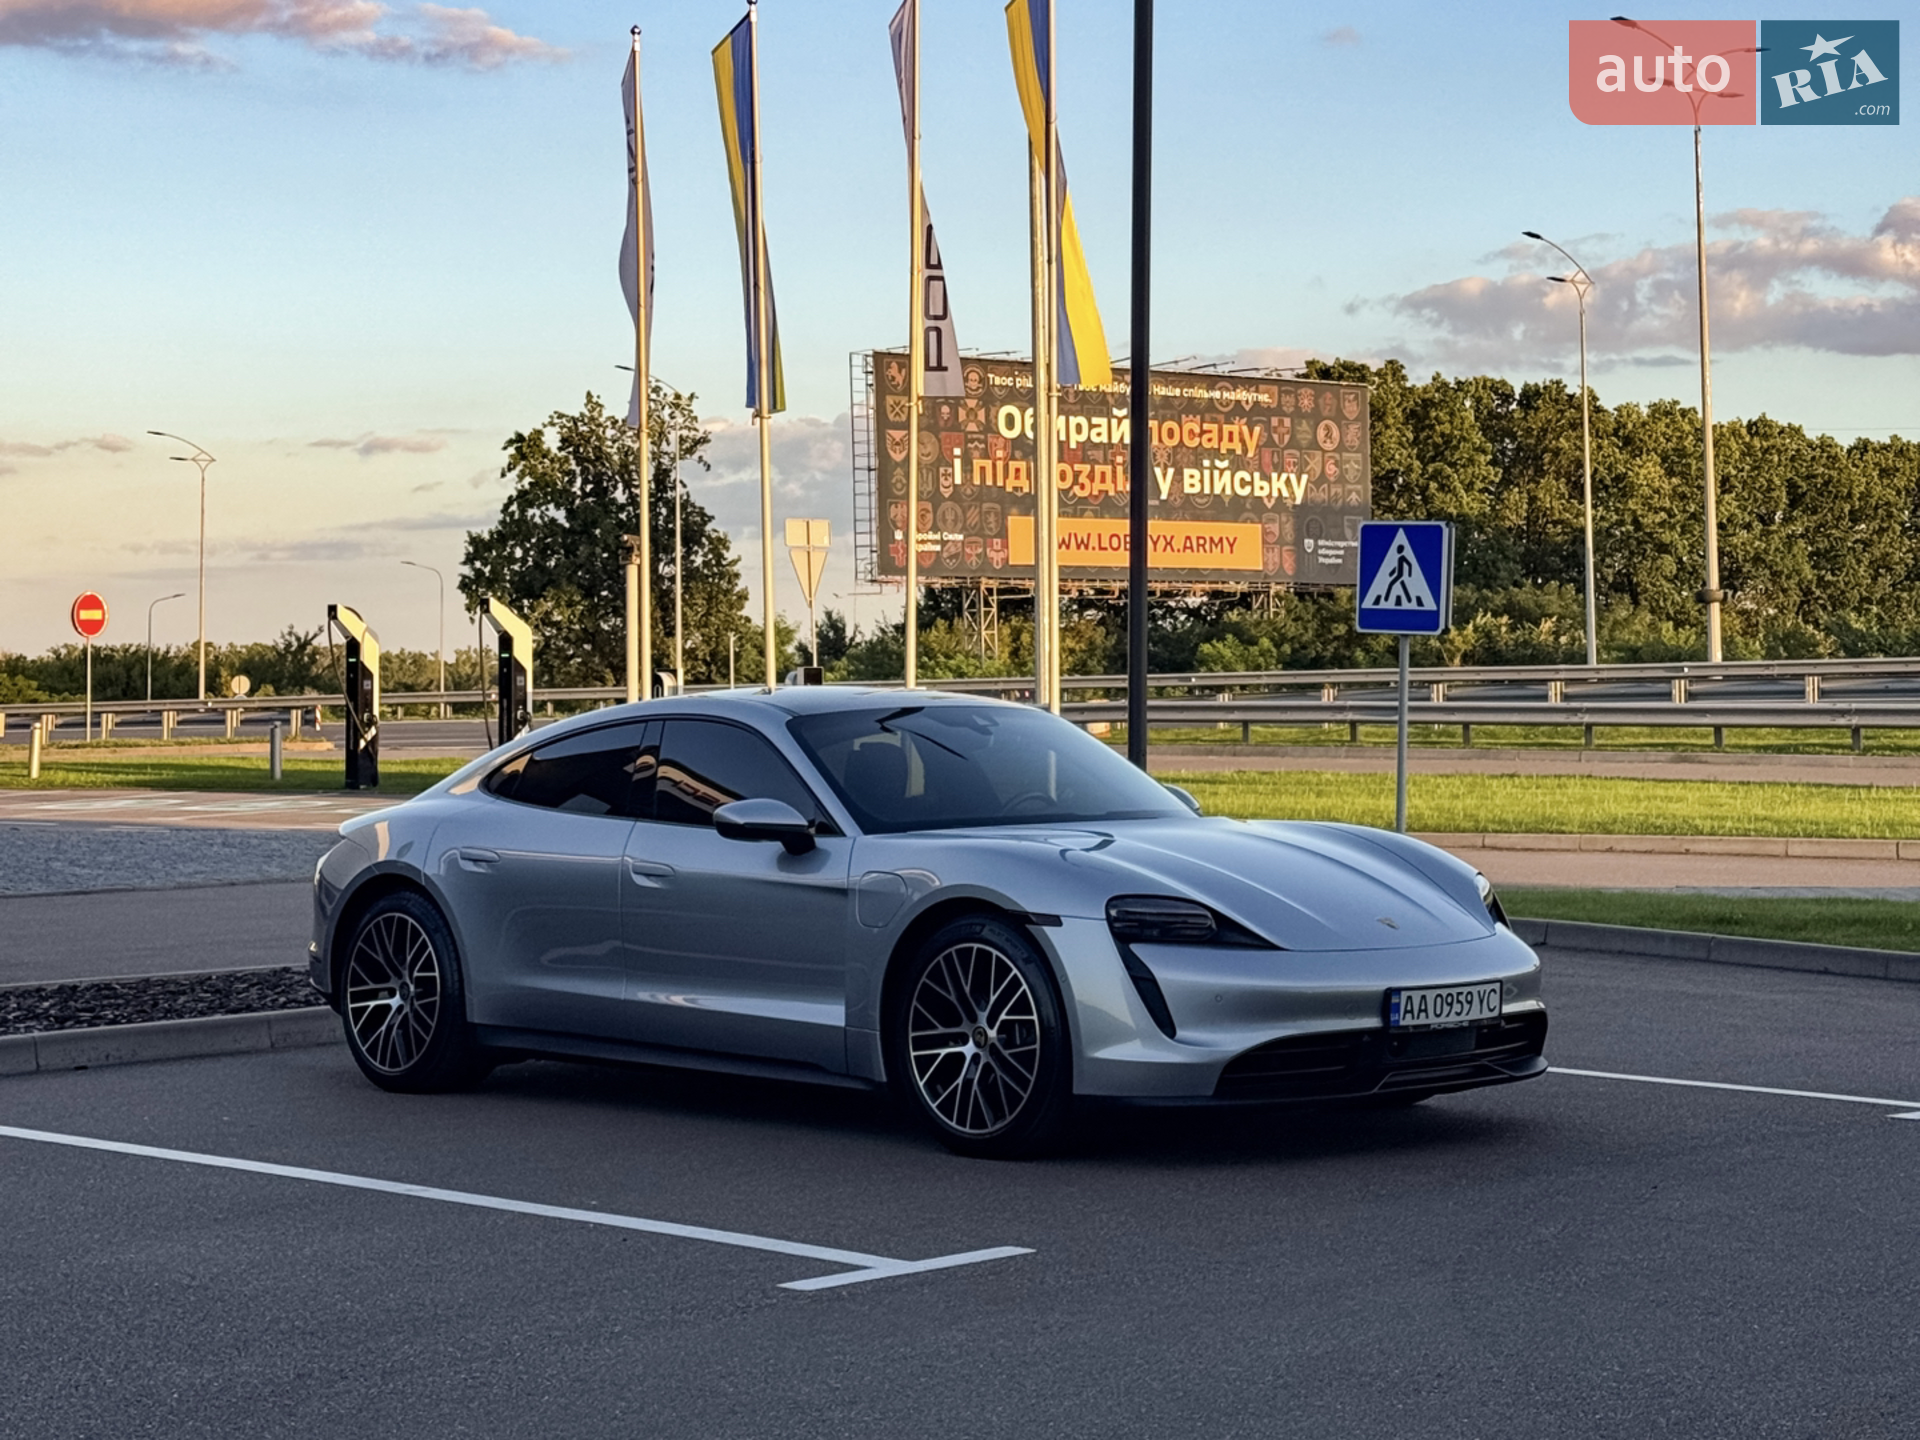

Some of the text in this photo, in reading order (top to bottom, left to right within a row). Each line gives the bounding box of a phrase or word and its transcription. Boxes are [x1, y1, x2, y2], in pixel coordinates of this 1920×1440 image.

[1153, 385, 1181, 397] Наше
[1183, 387, 1221, 400] спільне
[973, 450, 1130, 497] підозді
[1154, 467, 1175, 500] у
[1183, 459, 1309, 505] війську
[1058, 532, 1238, 554] WW.LOYX.ARMY
[1402, 994, 1429, 1021] AA
[1433, 991, 1474, 1018] 0959
